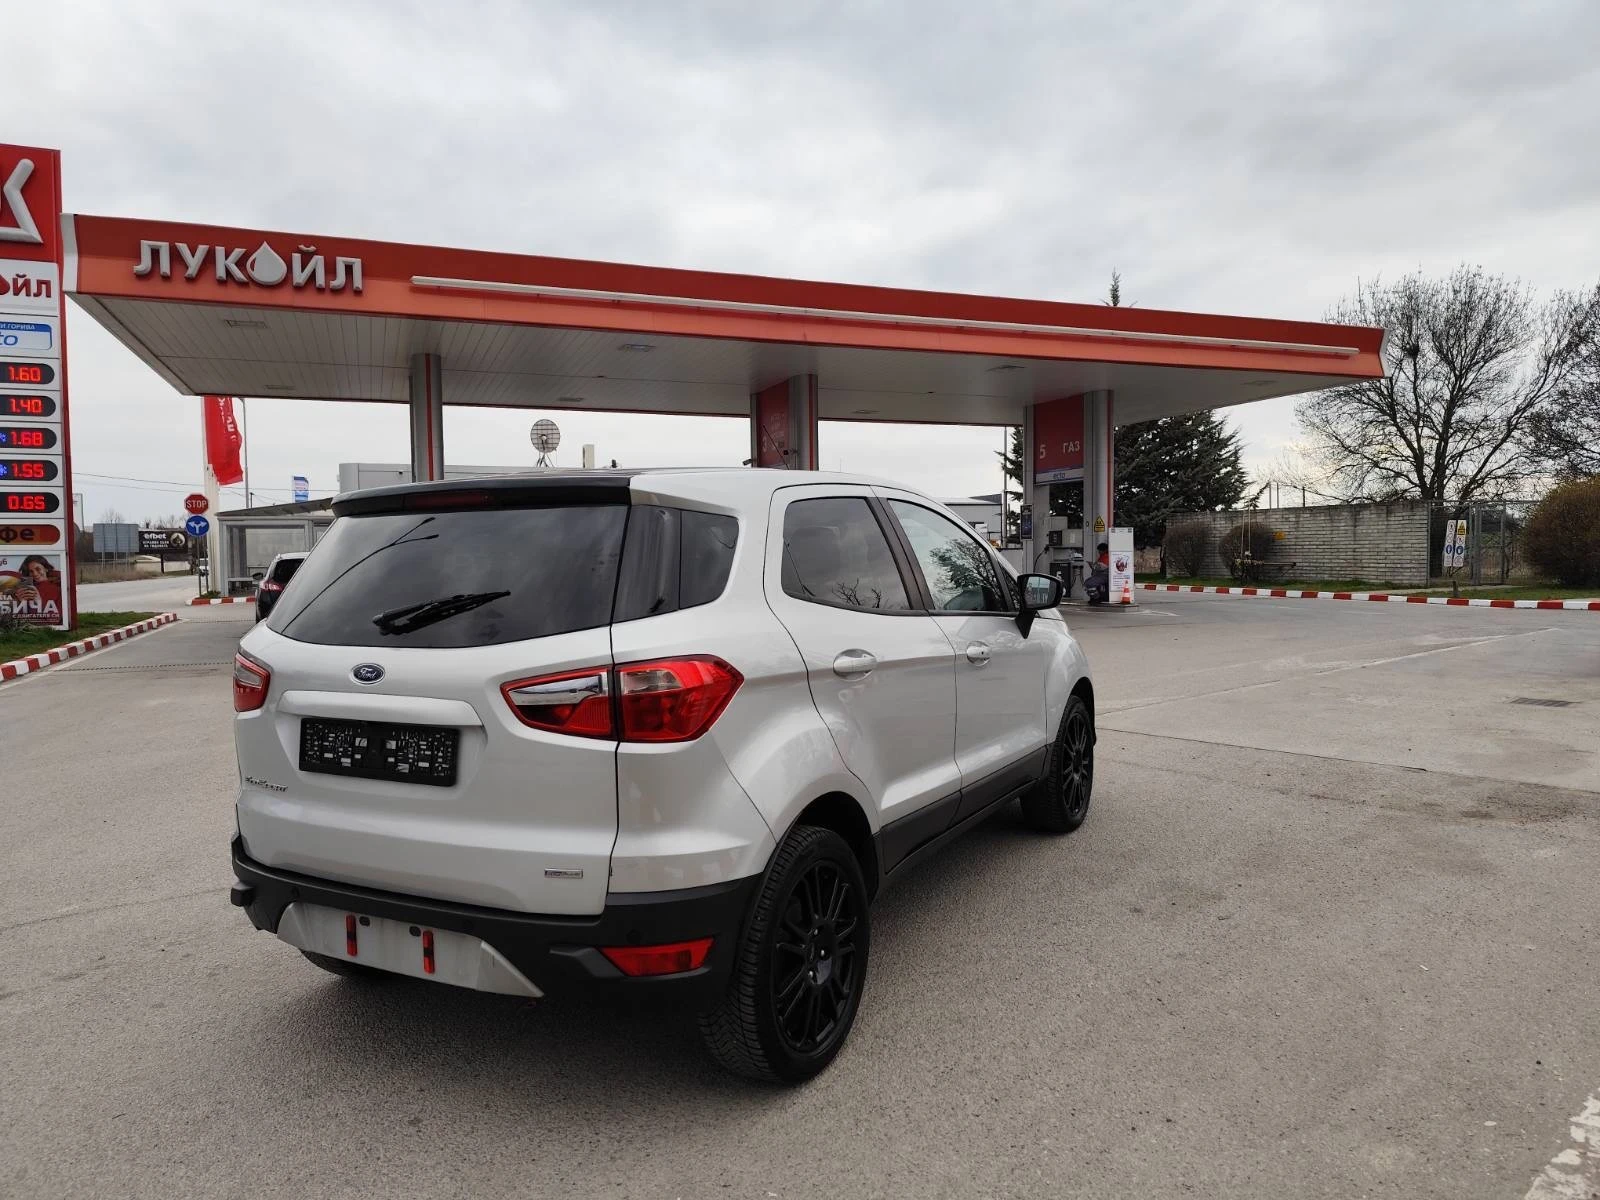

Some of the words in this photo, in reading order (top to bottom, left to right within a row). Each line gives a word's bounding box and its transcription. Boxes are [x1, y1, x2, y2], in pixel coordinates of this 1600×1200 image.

[133, 240, 363, 292] ЛУКОЙЛ
[8, 366, 42, 382] 1.60
[10, 398, 43, 413] 1.40
[1039, 444, 1046, 460] 5
[1063, 440, 1080, 454] ГАЗ
[12, 463, 44, 478] 1.55
[8, 495, 46, 510] 0.65
[186, 500, 207, 509] STOP
